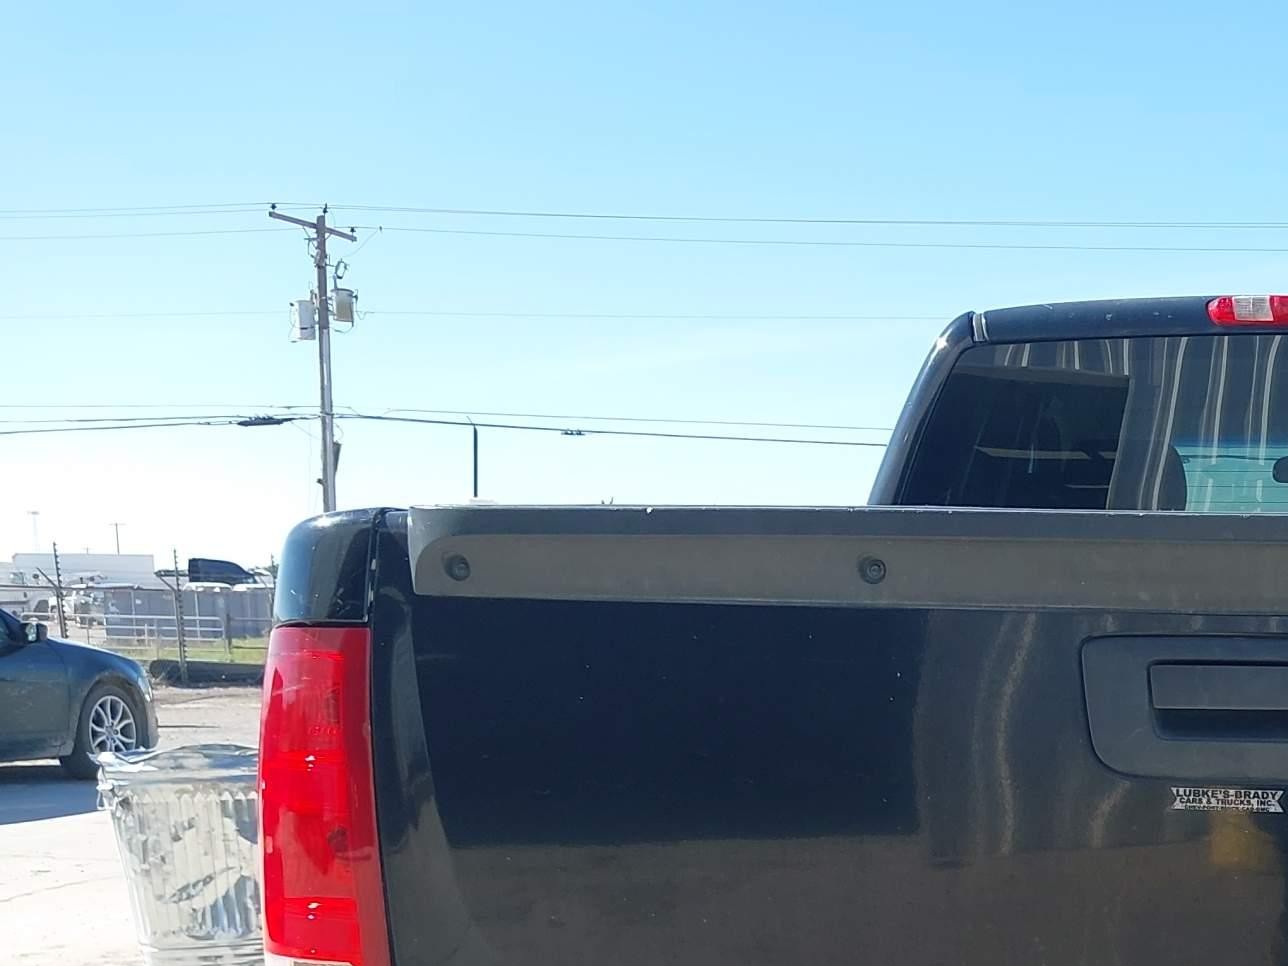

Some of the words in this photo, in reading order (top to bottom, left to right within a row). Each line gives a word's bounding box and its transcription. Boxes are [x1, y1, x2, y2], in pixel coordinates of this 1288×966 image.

[1175, 788, 1279, 800] LUBKE'S-BRADY
[1179, 797, 1203, 805] CARS
[1215, 798, 1255, 807] TRUCKS,
[1256, 799, 1275, 807] INC.
